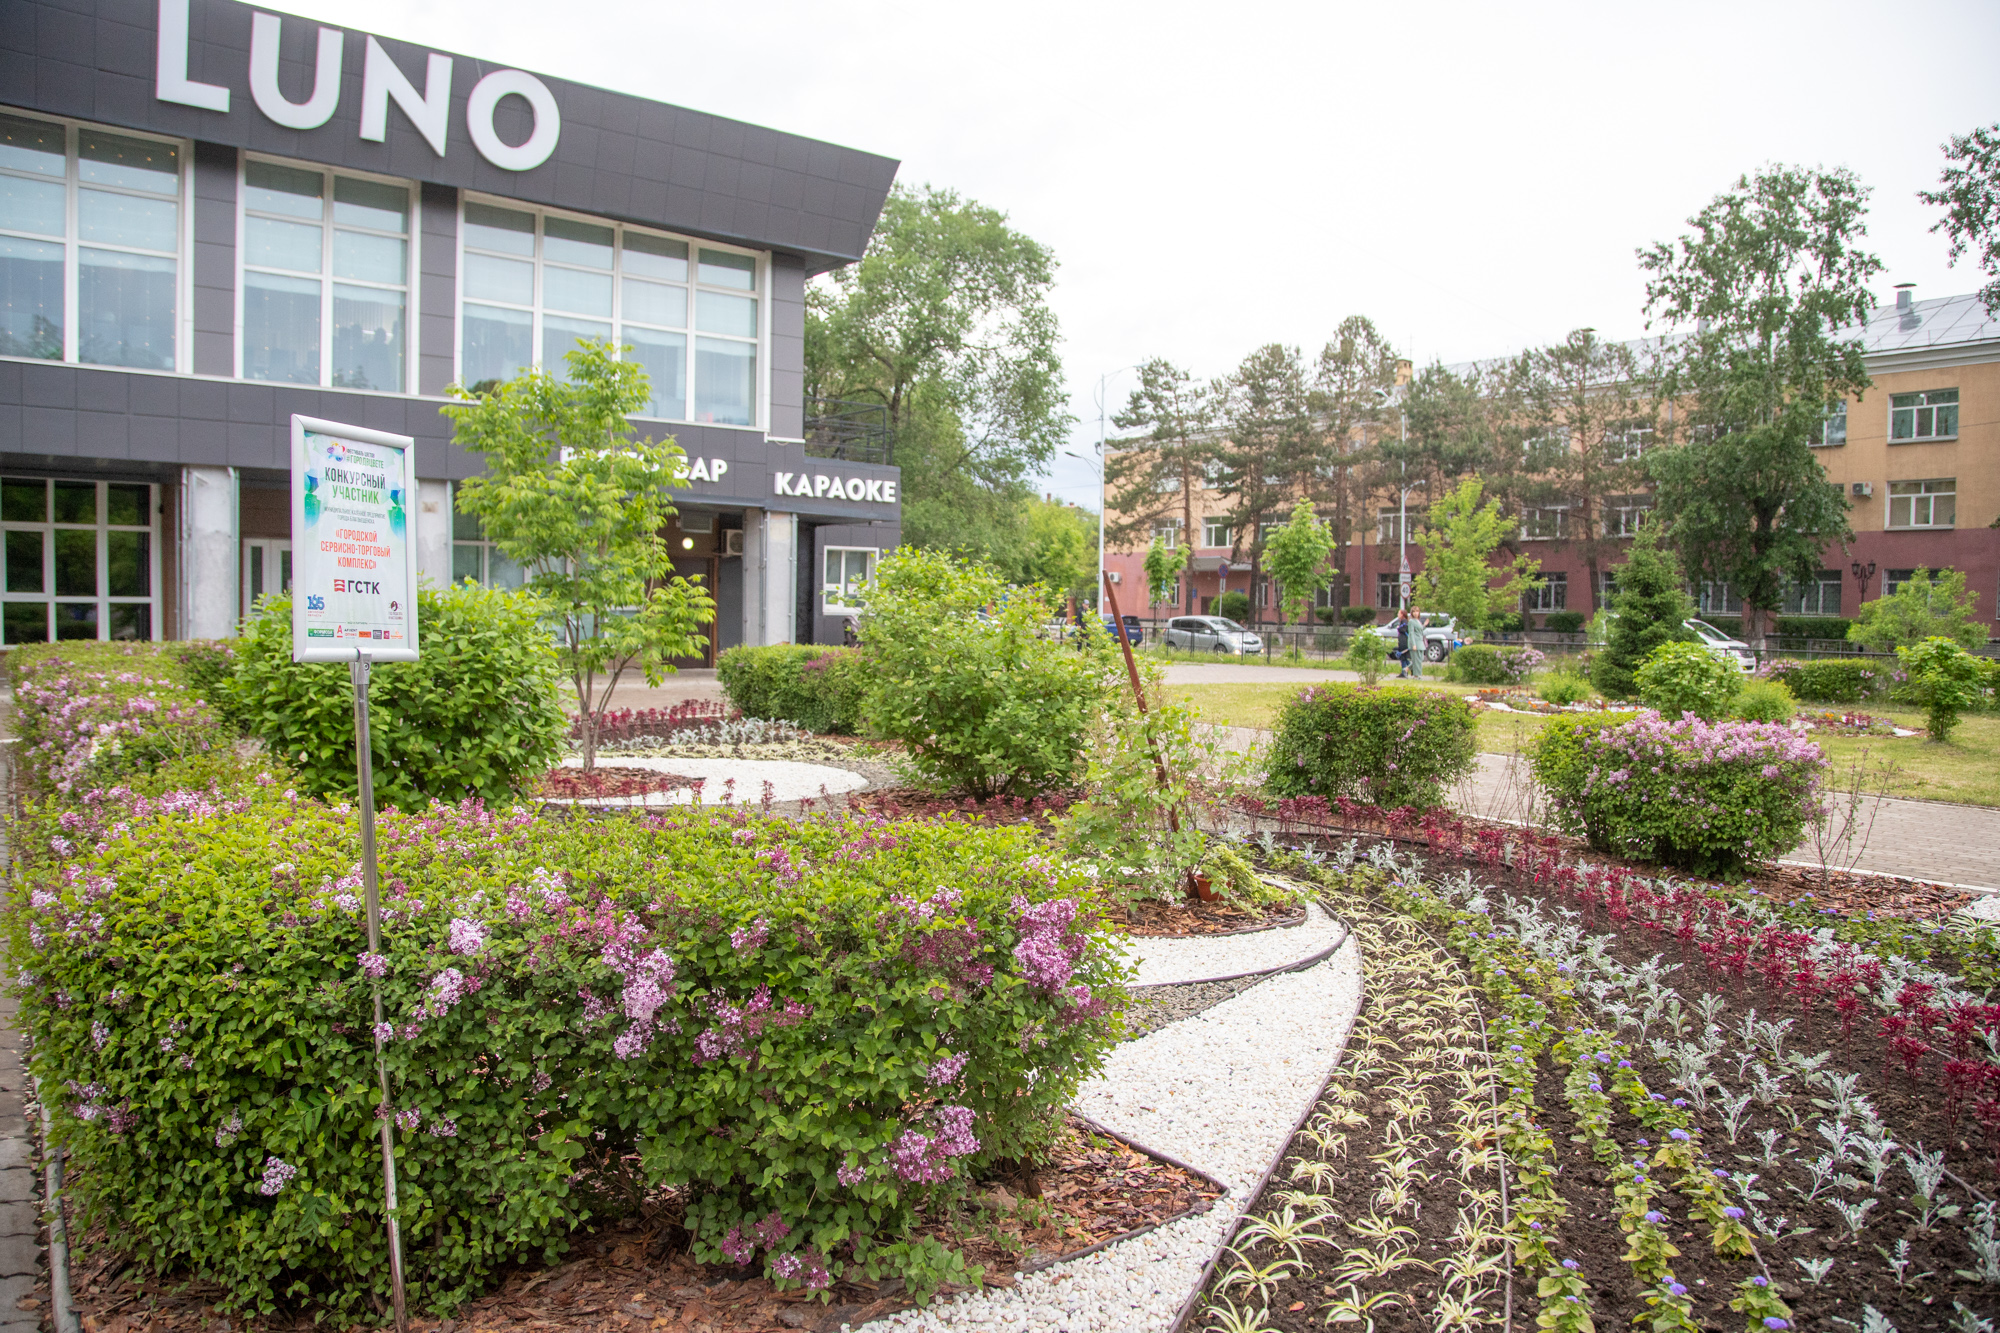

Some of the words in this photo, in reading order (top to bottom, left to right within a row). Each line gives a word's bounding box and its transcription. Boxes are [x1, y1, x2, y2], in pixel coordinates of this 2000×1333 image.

[156, 0, 561, 171] LUNO
[324, 466, 386, 490] КОНКУРСНЫЙ
[332, 484, 380, 505] УЧАСТНИК
[774, 472, 897, 503] КАРАОКЕ
[335, 528, 378, 543] «ГОРОДСКОЙ
[320, 540, 391, 558] СЕРВИСНО-ТОРГОВЫЙ
[337, 556, 377, 569] КОМПЛЕКС»
[347, 580, 380, 595] ГСТК
[1402, 586, 1409, 594] 40
